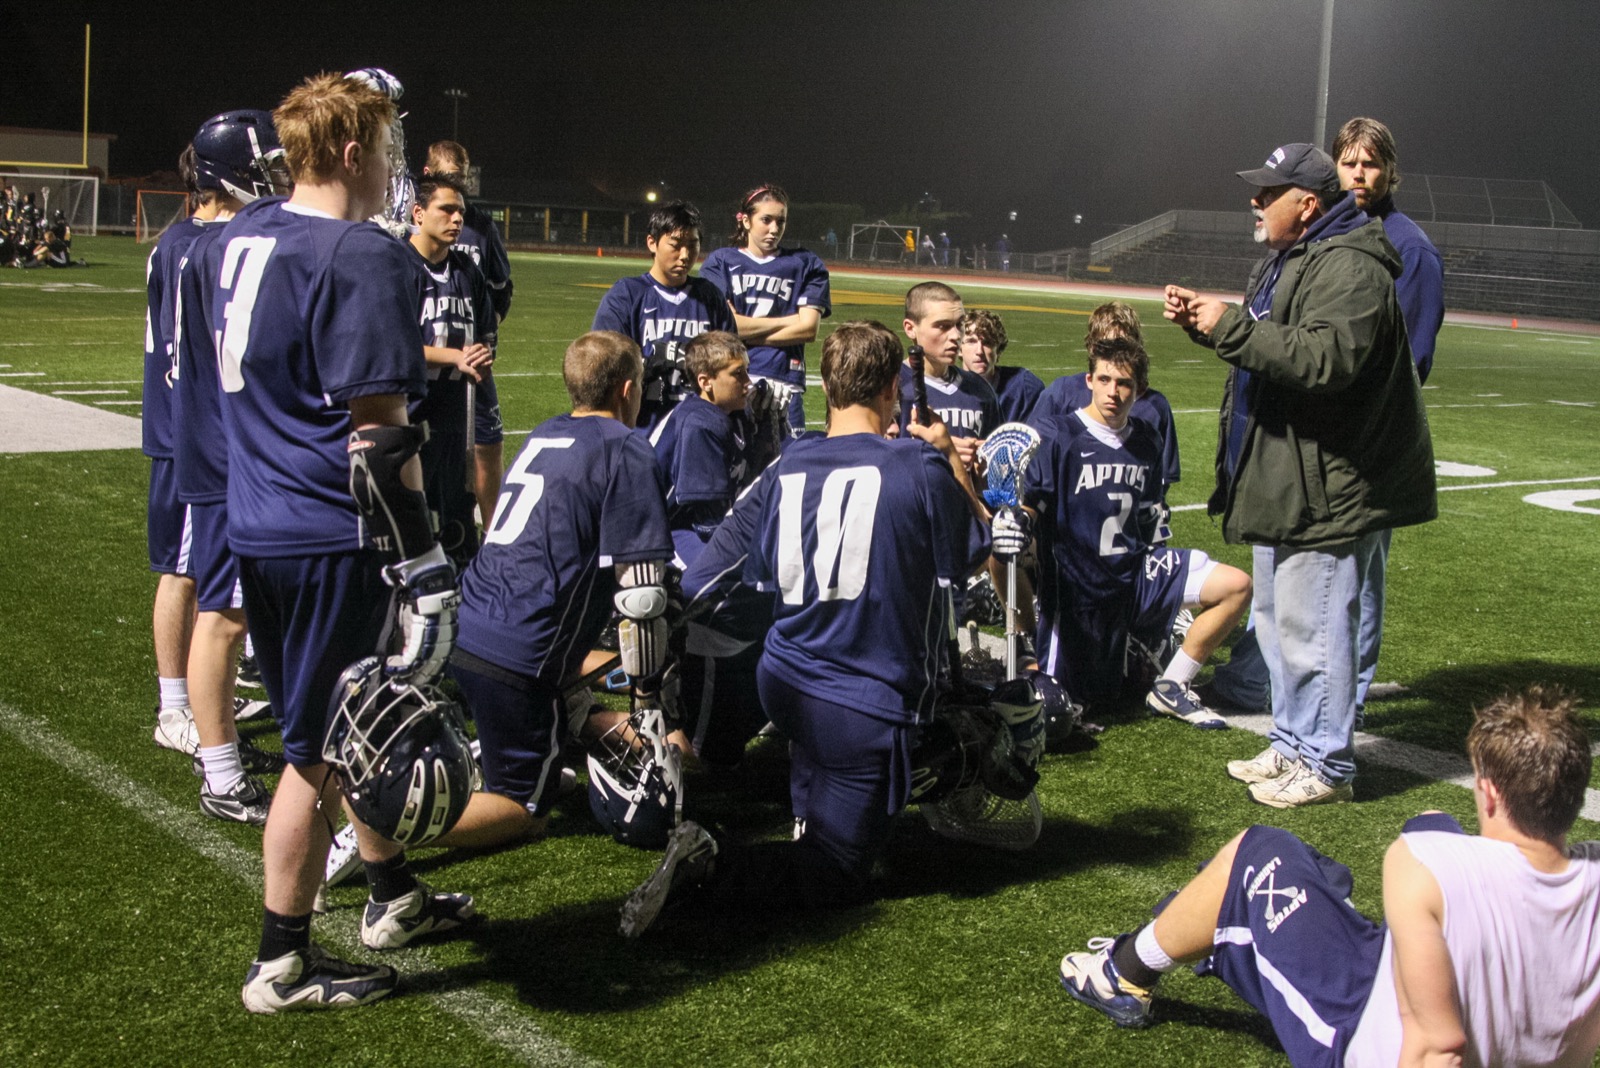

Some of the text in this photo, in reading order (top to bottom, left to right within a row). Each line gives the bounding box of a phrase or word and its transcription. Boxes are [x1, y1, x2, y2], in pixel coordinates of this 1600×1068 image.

[732, 274, 796, 302] APTOS
[420, 298, 475, 326] APTOS
[643, 319, 711, 347] APTOS
[933, 408, 984, 437] PTOS
[484, 437, 576, 545] 5
[1074, 464, 1149, 495] APTOS
[777, 465, 882, 606] 10
[1099, 492, 1133, 556] 2
[1266, 888, 1308, 934] APTOS
